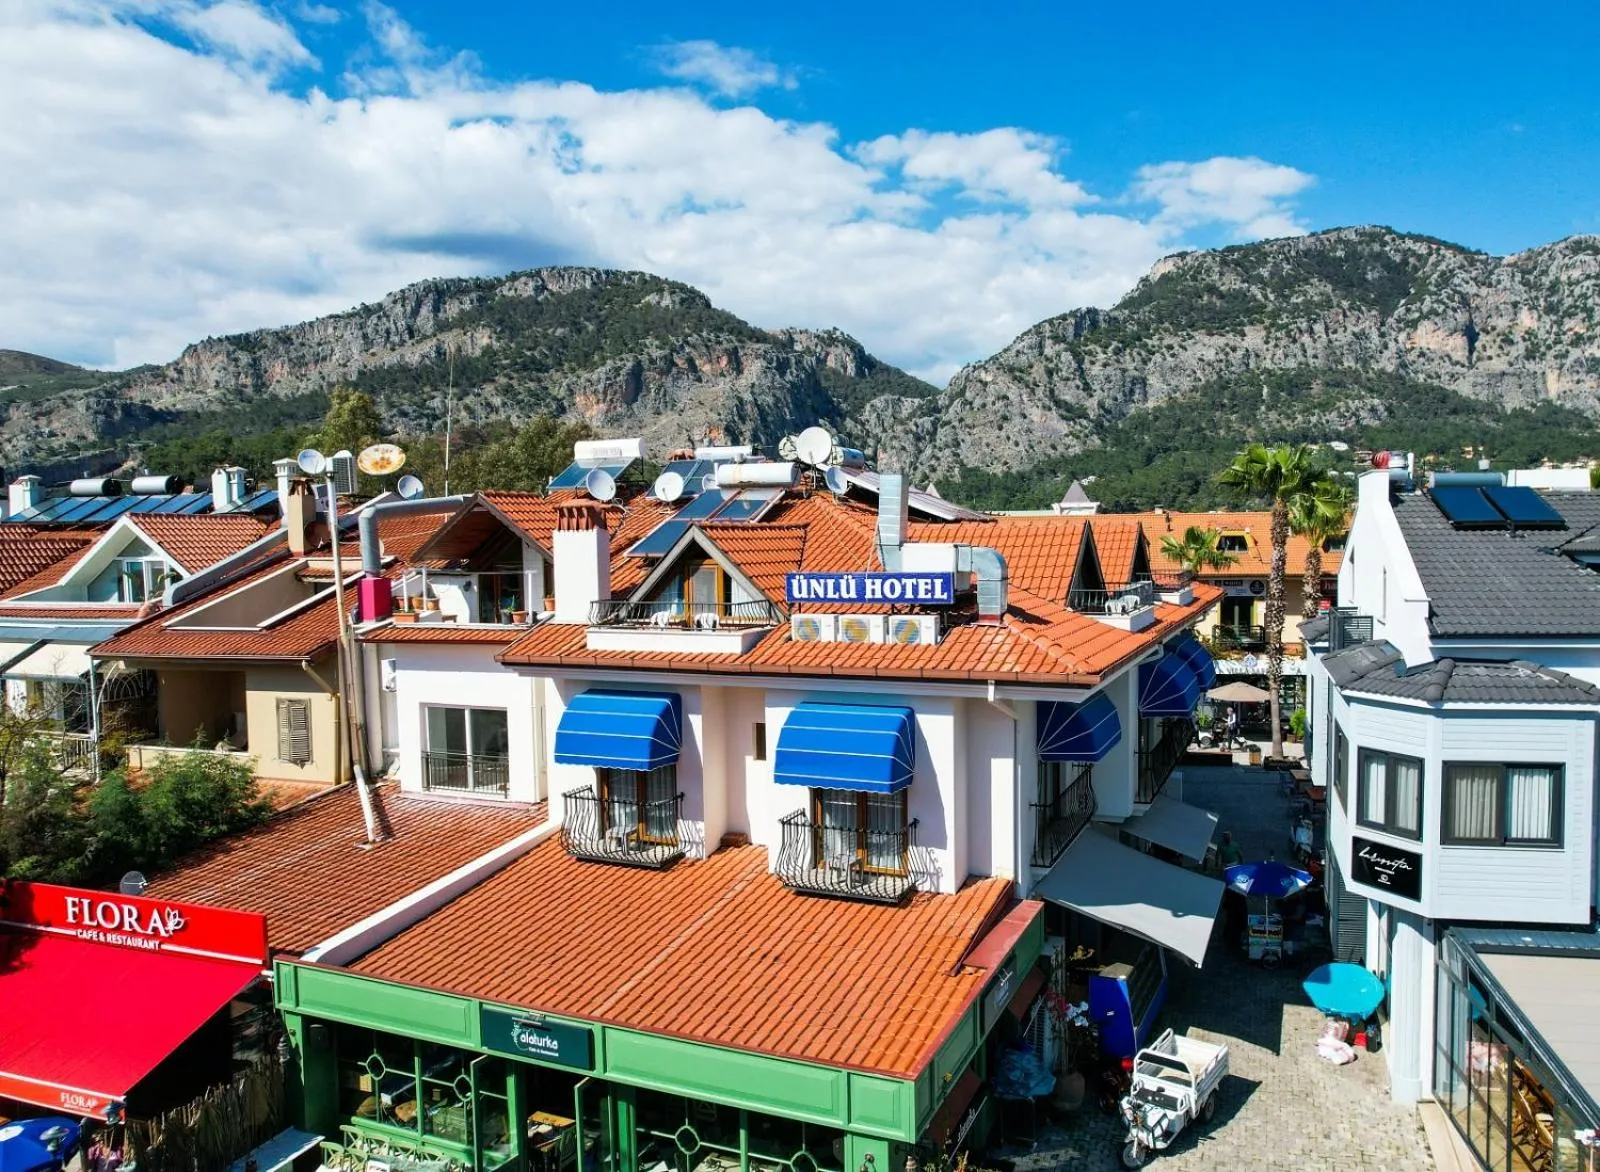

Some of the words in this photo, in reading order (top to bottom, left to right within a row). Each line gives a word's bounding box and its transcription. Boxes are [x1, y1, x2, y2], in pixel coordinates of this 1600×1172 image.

[791, 575, 857, 599] ÜNLÜ
[864, 578, 948, 600] HOTEL
[64, 896, 169, 937] FLORA
[77, 929, 98, 941] CAFE
[99, 931, 105, 942] &
[106, 933, 160, 950] RESTAURANT
[61, 1092, 93, 1107] FLORA
